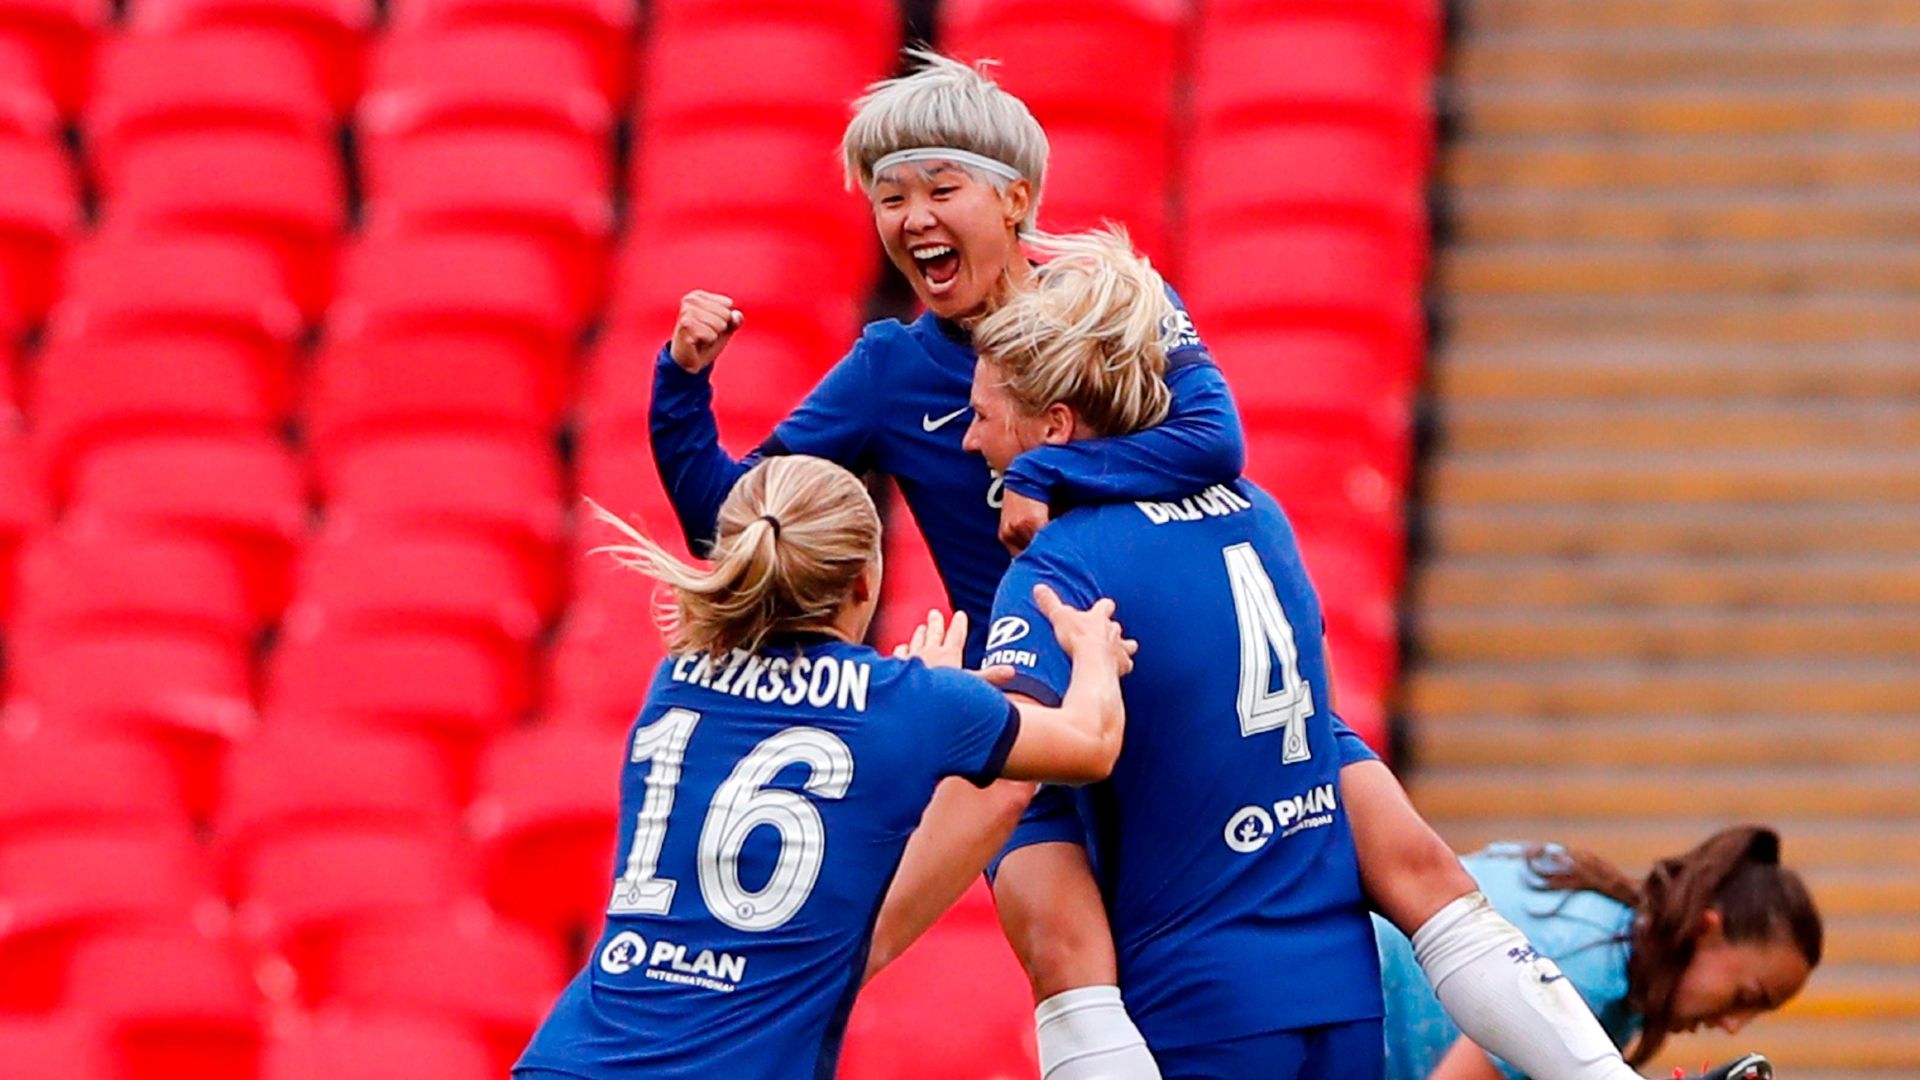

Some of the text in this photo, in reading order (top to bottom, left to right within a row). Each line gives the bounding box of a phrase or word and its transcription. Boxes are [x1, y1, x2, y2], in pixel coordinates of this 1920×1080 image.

[1222, 542, 1314, 764] 4
[607, 707, 854, 932] 16
[650, 941, 746, 982] PLAN
